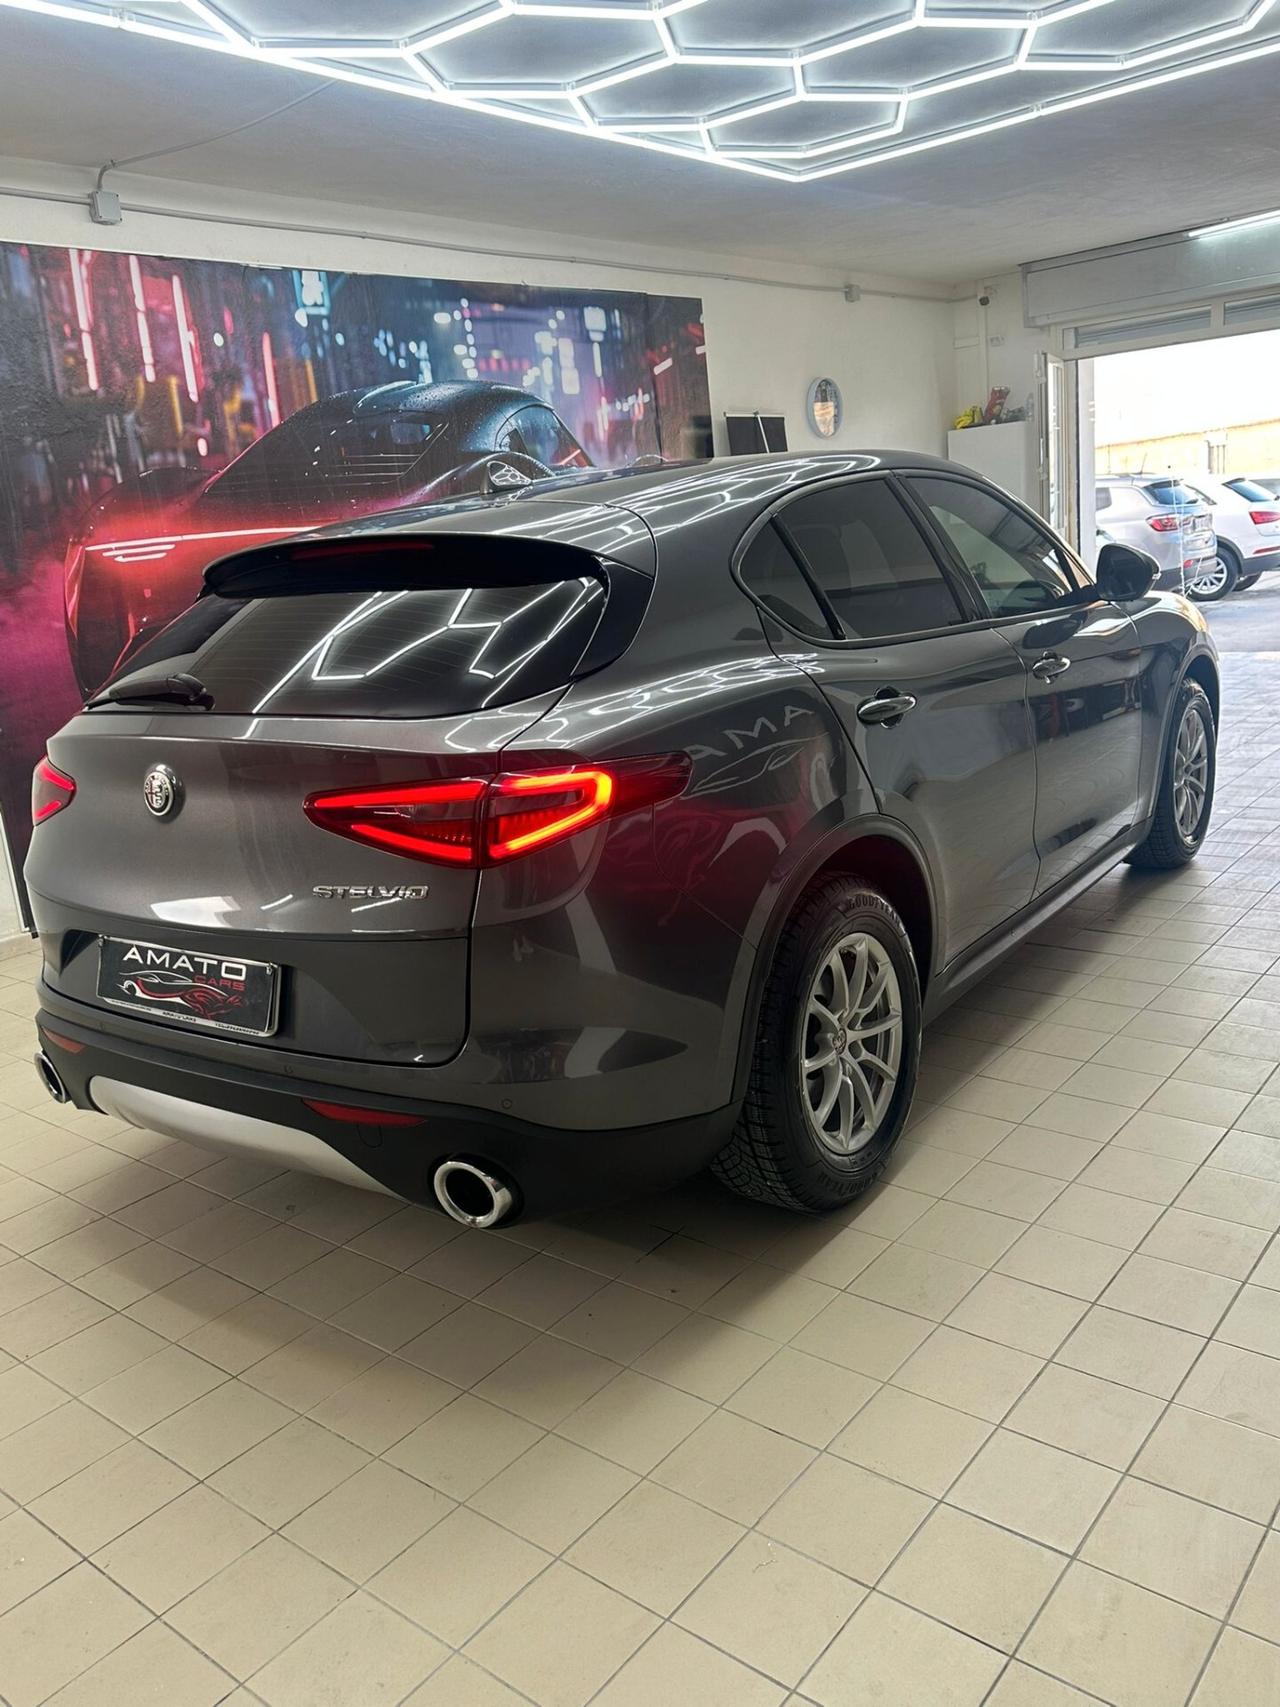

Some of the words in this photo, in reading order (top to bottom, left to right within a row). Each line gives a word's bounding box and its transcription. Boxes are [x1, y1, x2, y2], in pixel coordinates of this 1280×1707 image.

[313, 885, 429, 899] STELVIO
[122, 944, 246, 981] AMATO
[194, 975, 246, 992] CARS
